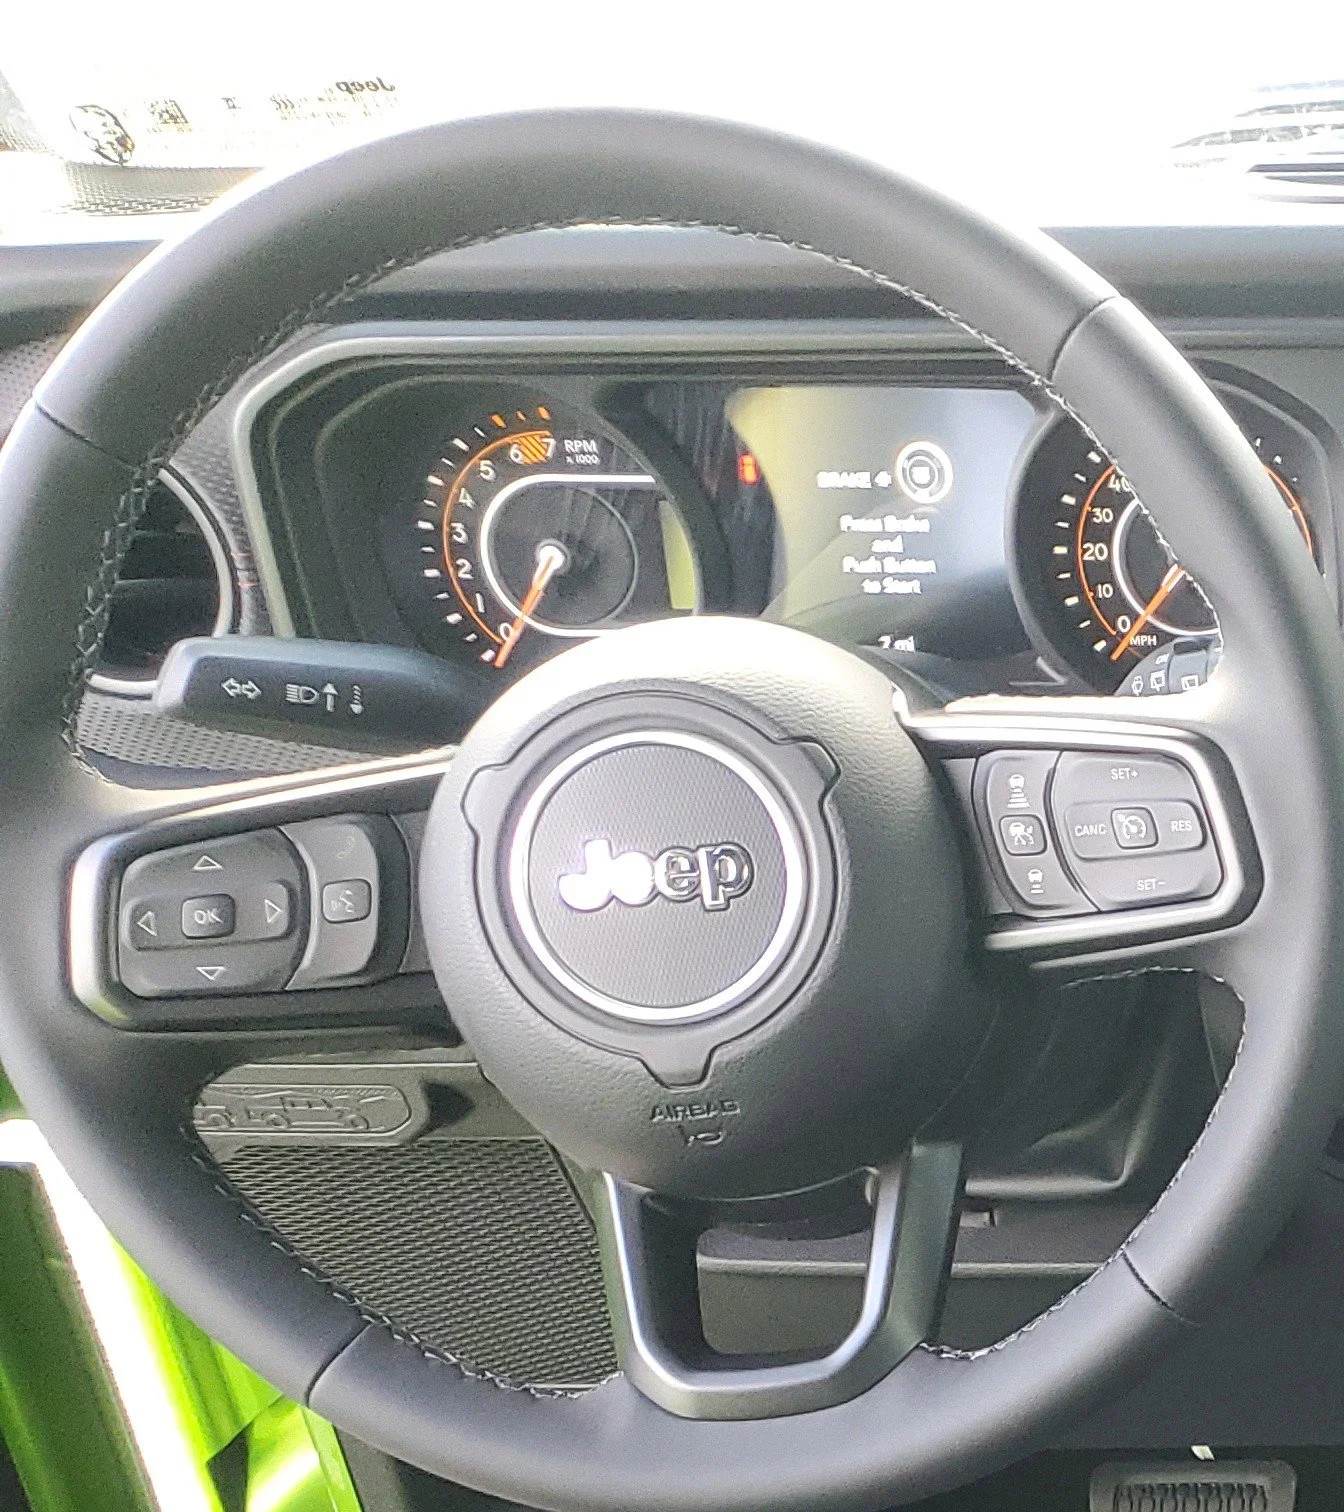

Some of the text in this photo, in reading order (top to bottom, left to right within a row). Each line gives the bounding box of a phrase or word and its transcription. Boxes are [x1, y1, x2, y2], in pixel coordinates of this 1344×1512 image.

[508, 443, 524, 465] 6
[539, 437, 556, 463] 7
[563, 440, 599, 453] RPM
[576, 454, 599, 465] 1000
[479, 460, 497, 481] 5
[1109, 475, 1134, 493] 40
[458, 487, 475, 509] 4
[1091, 507, 1114, 523] 30
[450, 522, 468, 545] 3
[1082, 543, 1109, 561] 20
[455, 558, 475, 579] 2
[1095, 582, 1114, 599] 10
[474, 592, 485, 614] 1
[499, 623, 514, 641] 0
[1116, 615, 1131, 633] 0
[1129, 634, 1157, 647] MPH
[1074, 823, 1106, 837] CANC
[1170, 819, 1193, 832] RES
[558, 838, 756, 913] Jeep
[194, 907, 224, 925] OK
[651, 1100, 741, 1123] AIRBAG
